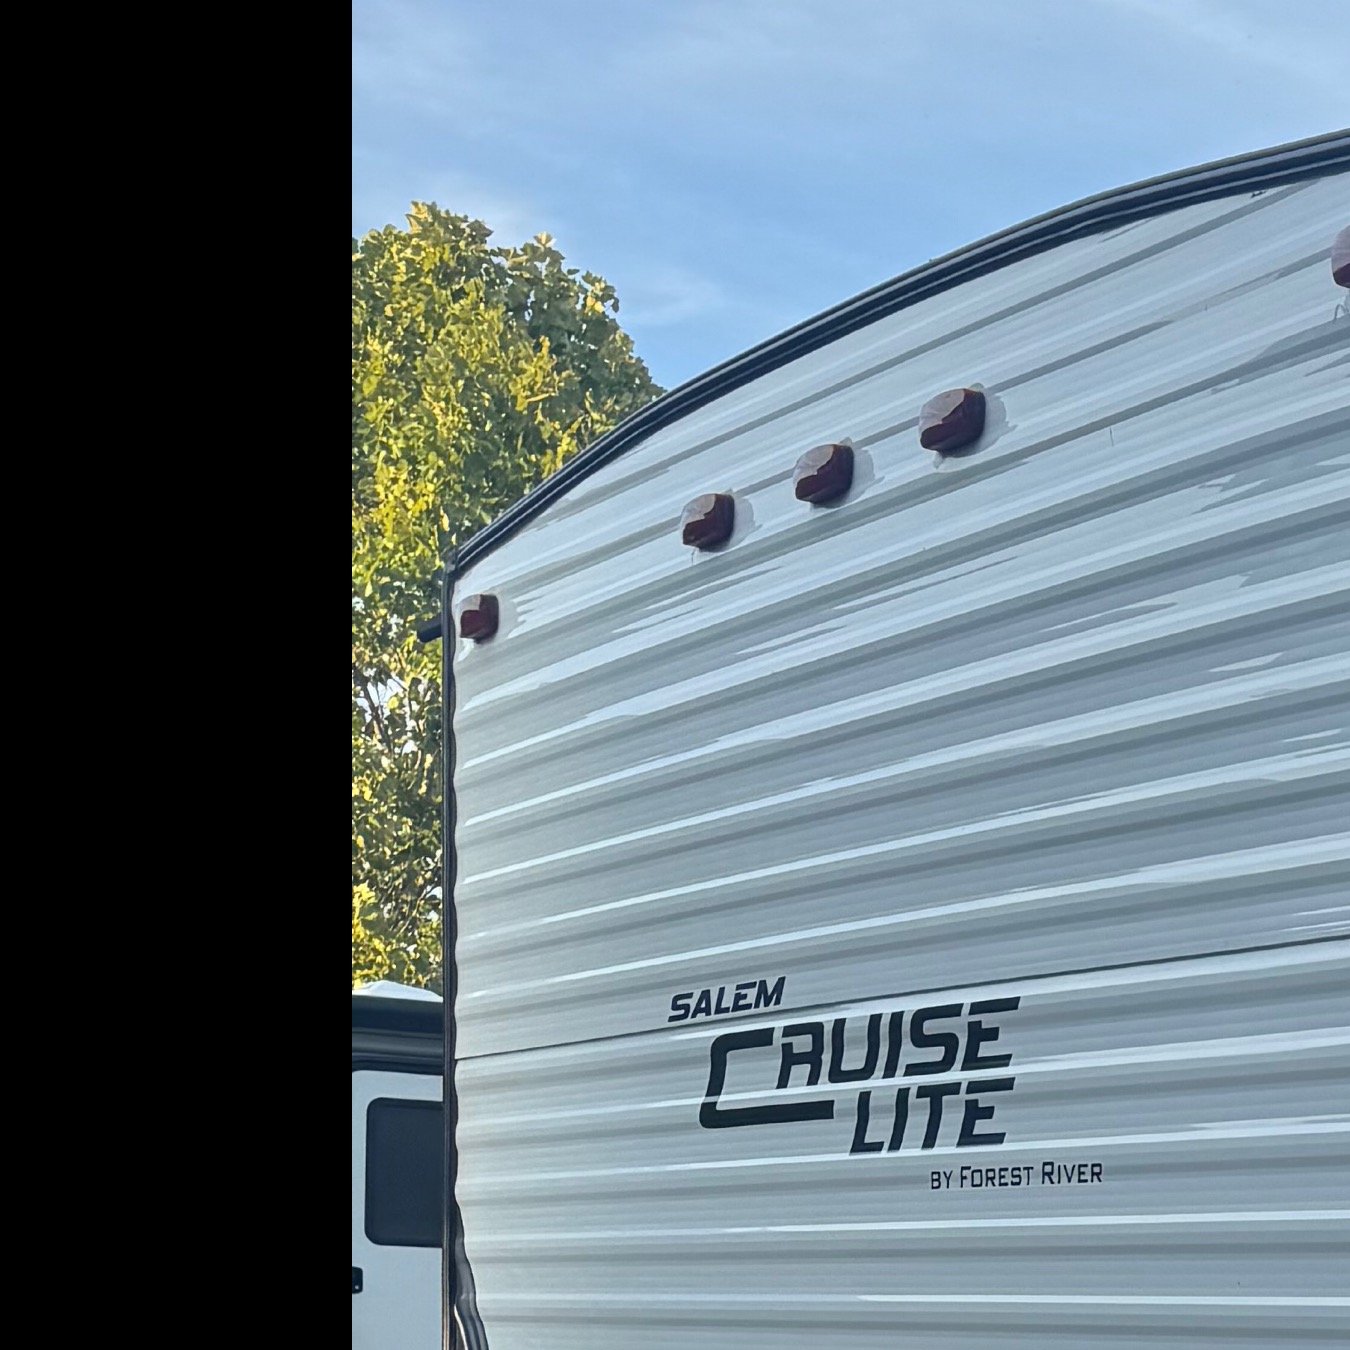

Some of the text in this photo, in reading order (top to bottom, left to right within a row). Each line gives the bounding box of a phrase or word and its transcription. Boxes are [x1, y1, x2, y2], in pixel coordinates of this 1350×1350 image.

[667, 976, 787, 1023] SALEM
[699, 995, 1021, 1129] CRUISE
[849, 1076, 1017, 1155] LITE
